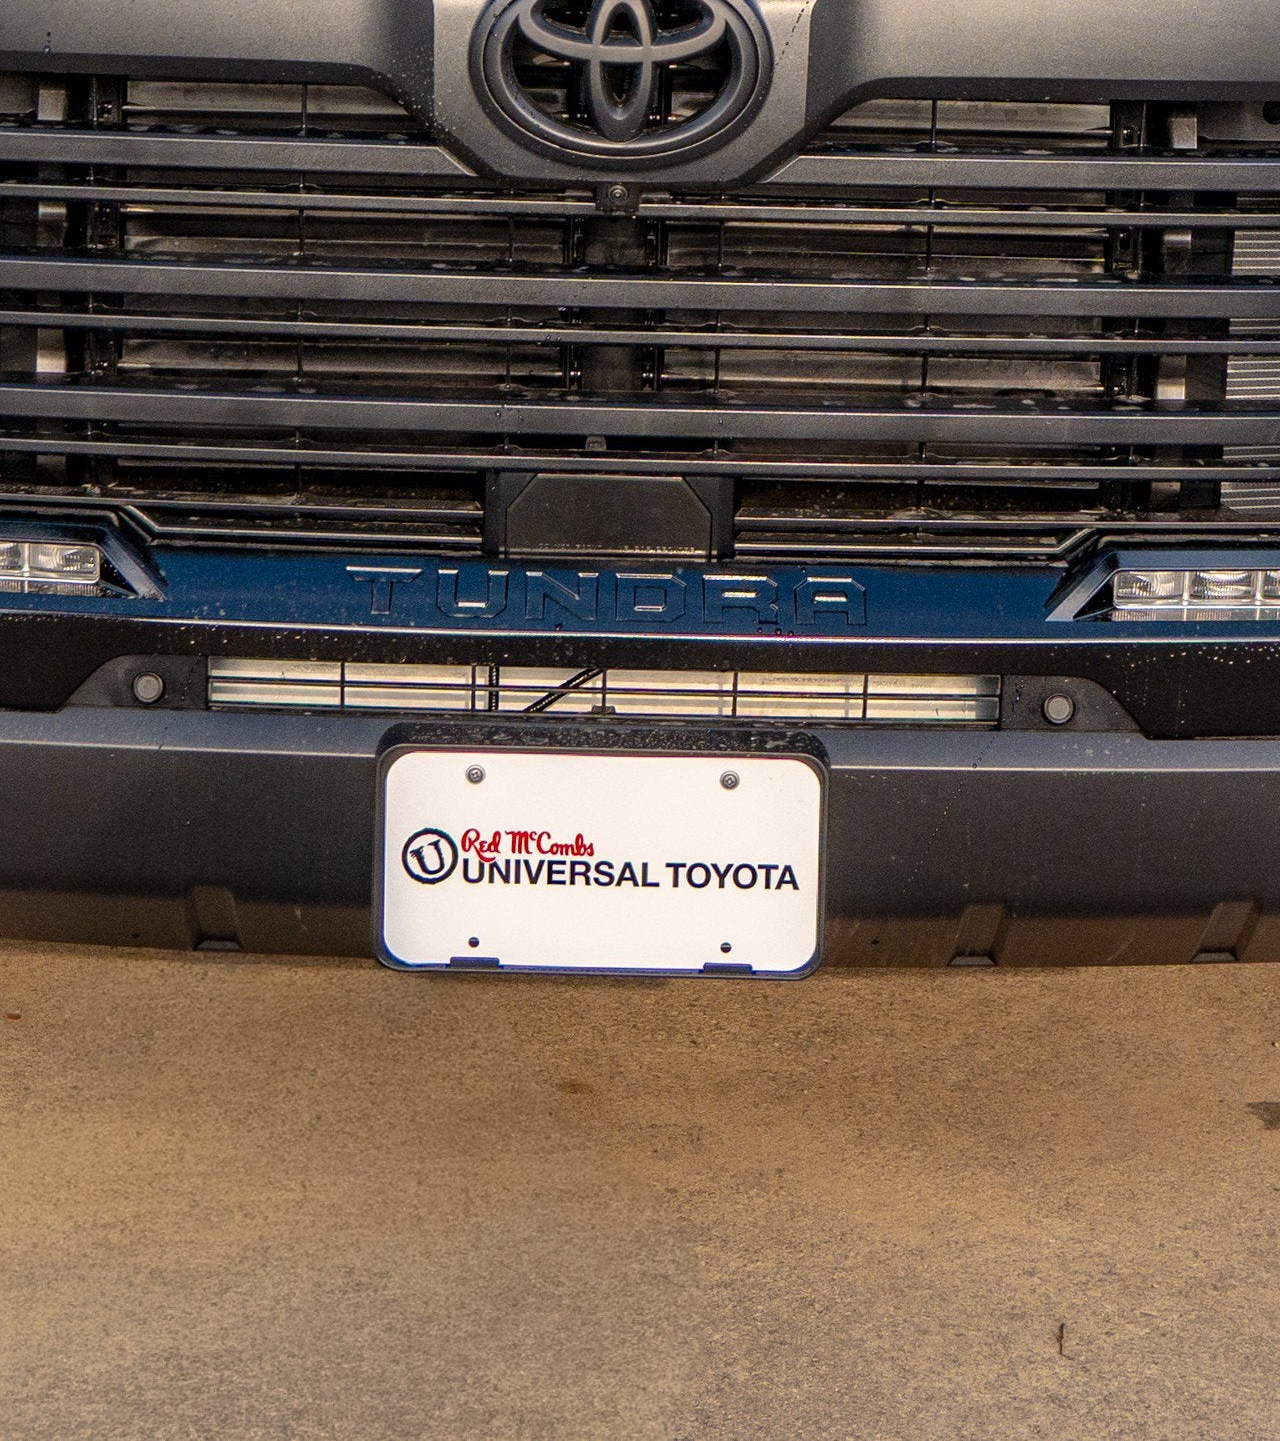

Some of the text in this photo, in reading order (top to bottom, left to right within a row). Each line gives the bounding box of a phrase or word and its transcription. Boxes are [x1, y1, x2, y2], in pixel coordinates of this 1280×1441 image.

[346, 565, 867, 627] TUNDRA
[460, 827, 595, 863] Red McCombs
[462, 857, 800, 892] UNIVERSAL TOYOTA
